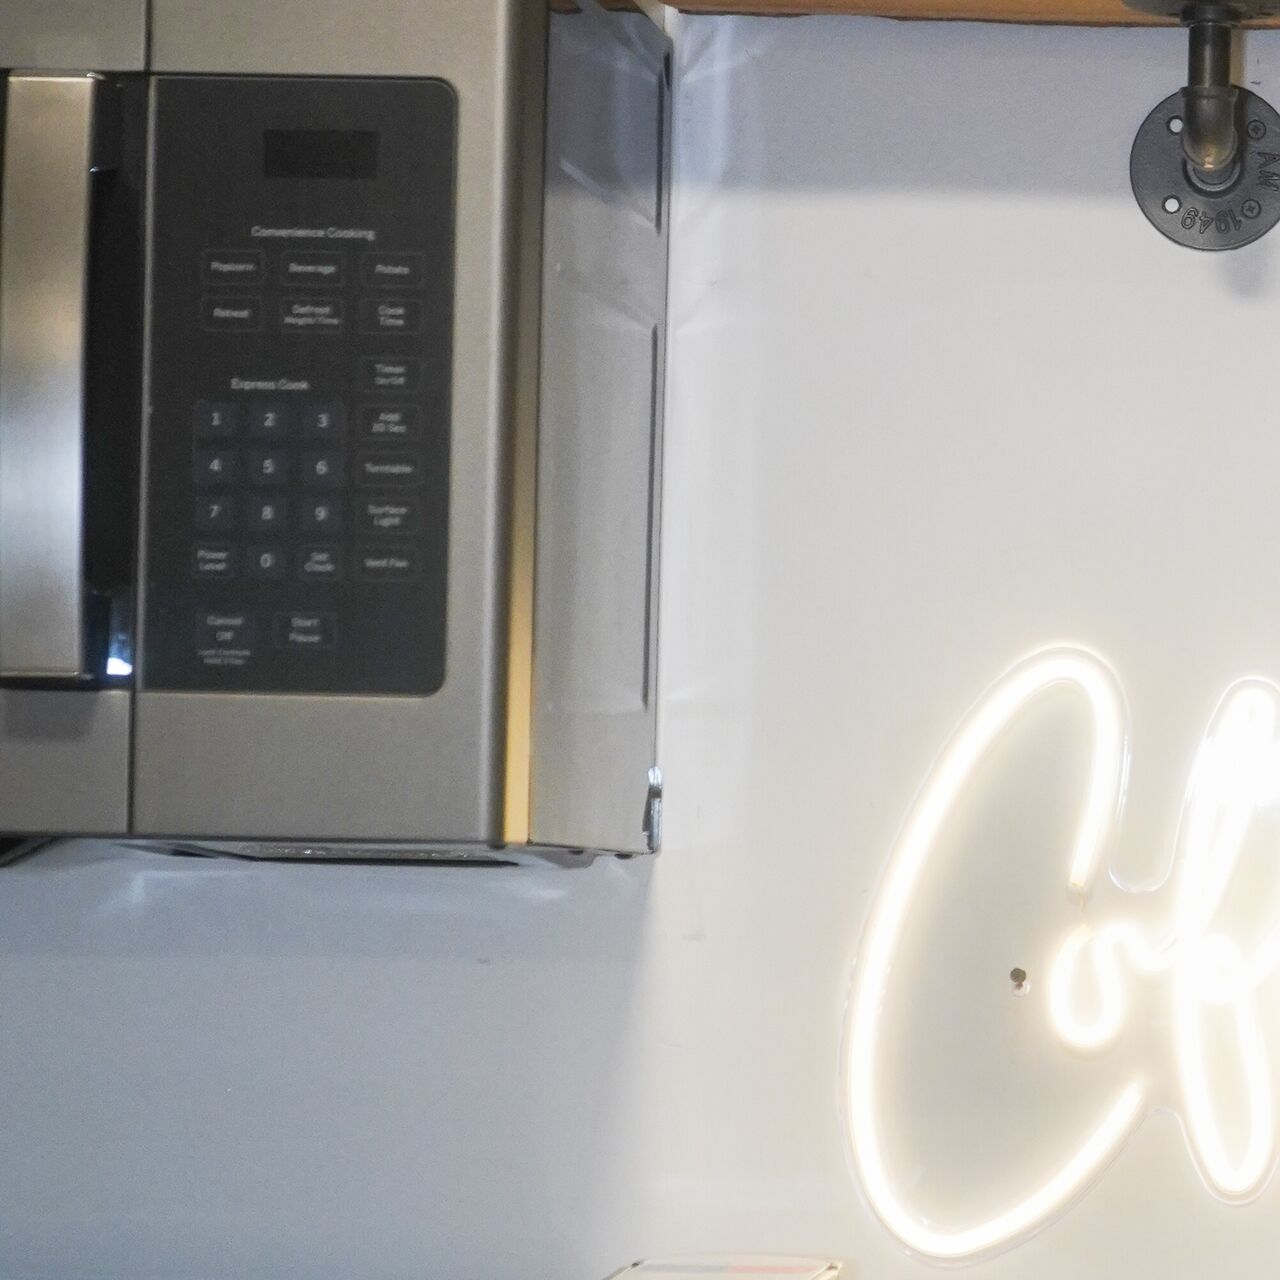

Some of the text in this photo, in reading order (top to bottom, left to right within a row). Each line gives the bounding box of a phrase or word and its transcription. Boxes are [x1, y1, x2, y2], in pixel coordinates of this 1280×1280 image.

[326, 227, 375, 240] Cooking
[211, 412, 220, 426] 1
[264, 412, 276, 426] 2
[317, 413, 328, 428] 3
[209, 458, 221, 472] 4
[263, 459, 275, 474] 5
[316, 460, 328, 475] 6
[209, 504, 221, 519] 7
[262, 505, 274, 520] 8
[315, 506, 327, 521] 9
